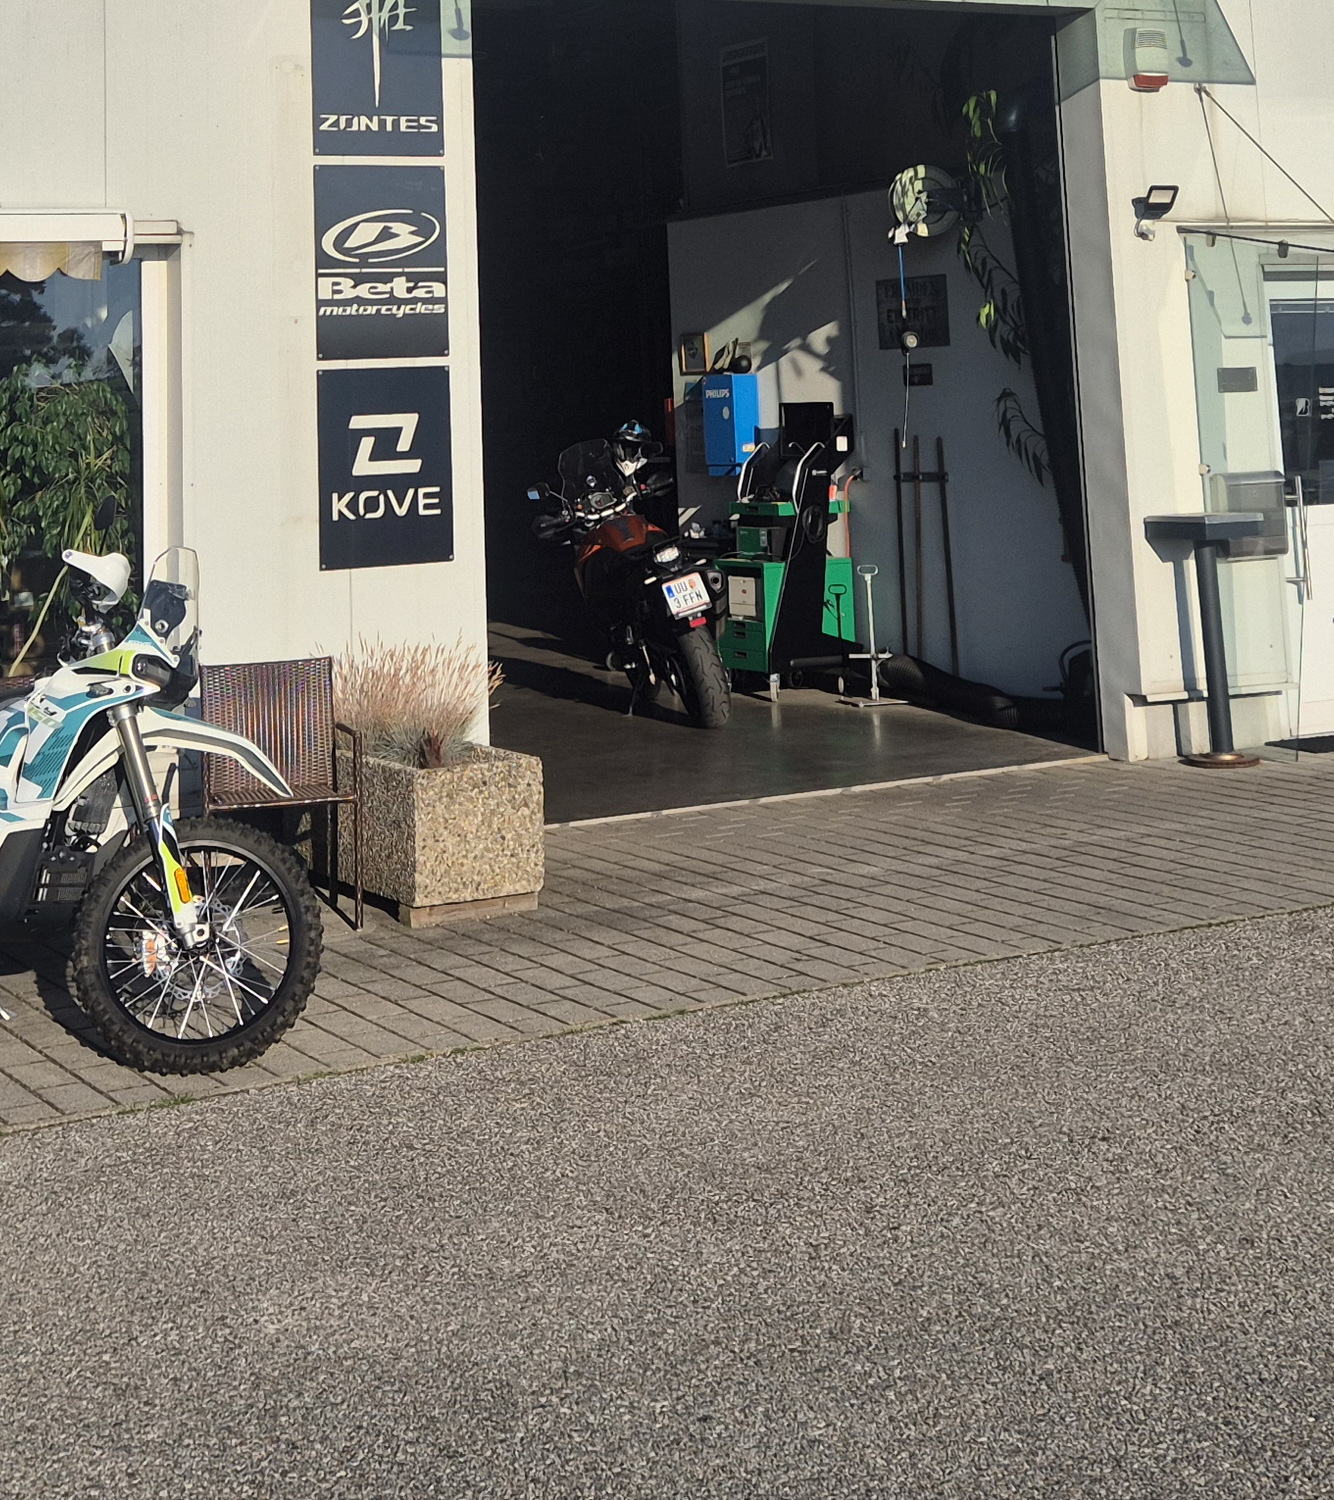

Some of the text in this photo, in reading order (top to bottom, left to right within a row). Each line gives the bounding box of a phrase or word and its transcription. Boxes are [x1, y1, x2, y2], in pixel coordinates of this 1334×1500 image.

[319, 114, 439, 134] ZONTES
[317, 276, 446, 301] Beta
[317, 303, 446, 318] motorcycles
[705, 388, 731, 399] PHILIPS
[331, 486, 442, 522] KOVE
[673, 597, 682, 609] 3
